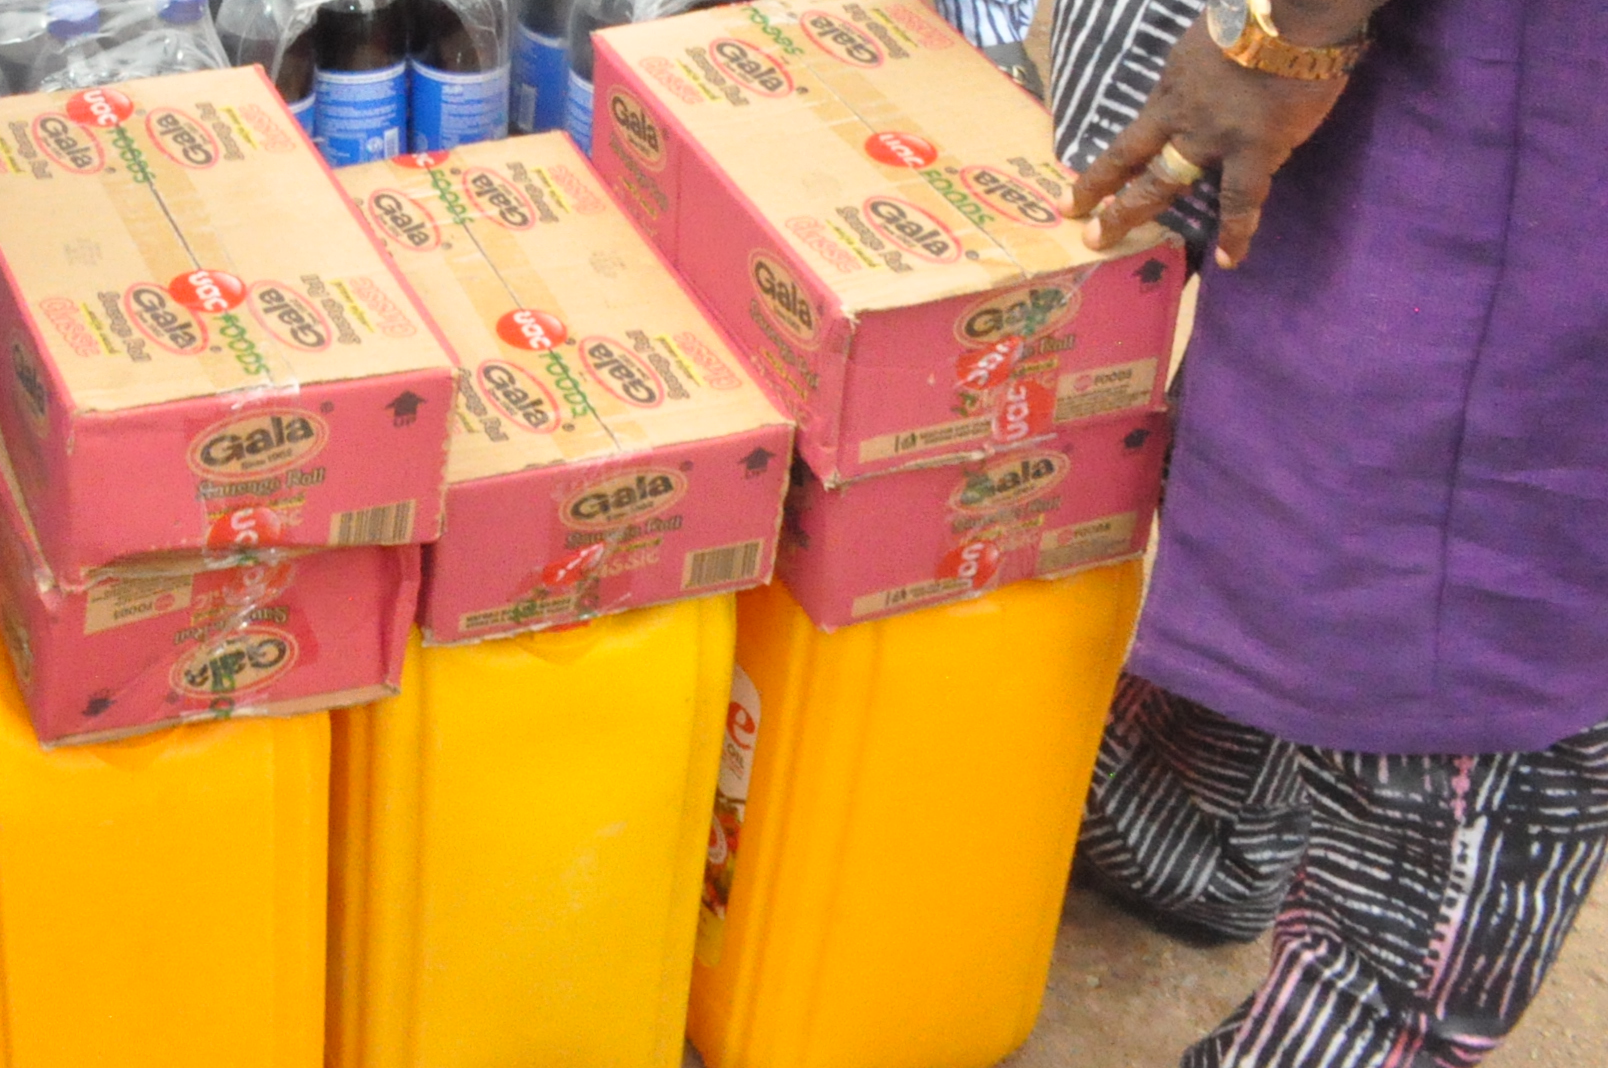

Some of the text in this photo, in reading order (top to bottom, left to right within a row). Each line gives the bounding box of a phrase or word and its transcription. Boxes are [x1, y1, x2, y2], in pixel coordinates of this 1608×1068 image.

[810, 15, 879, 64] Gala
[716, 42, 784, 92] Gala
[83, 89, 119, 125] uac
[612, 95, 659, 153] Gala
[40, 117, 92, 168] Gala
[108, 127, 156, 184] FOODS
[157, 113, 213, 165] Gala
[879, 133, 925, 167] uac
[374, 193, 430, 247] Gala
[430, 169, 475, 225] FOODS
[471, 173, 529, 227] Gala
[921, 169, 995, 226] FOODS
[973, 170, 1057, 224] Gala
[869, 200, 950, 257] Gala
[188, 270, 228, 312] uac
[258, 287, 326, 348] Gala
[754, 260, 813, 331] Gala
[133, 288, 197, 349] Gala
[213, 313, 271, 376] FOODS
[514, 311, 551, 349] uac
[483, 364, 549, 428] Gala
[540, 351, 589, 419] FOODS
[588, 343, 657, 404] Gala
[200, 416, 315, 467] Gala
[285, 467, 326, 489] Roll
[570, 473, 674, 522] Gala
